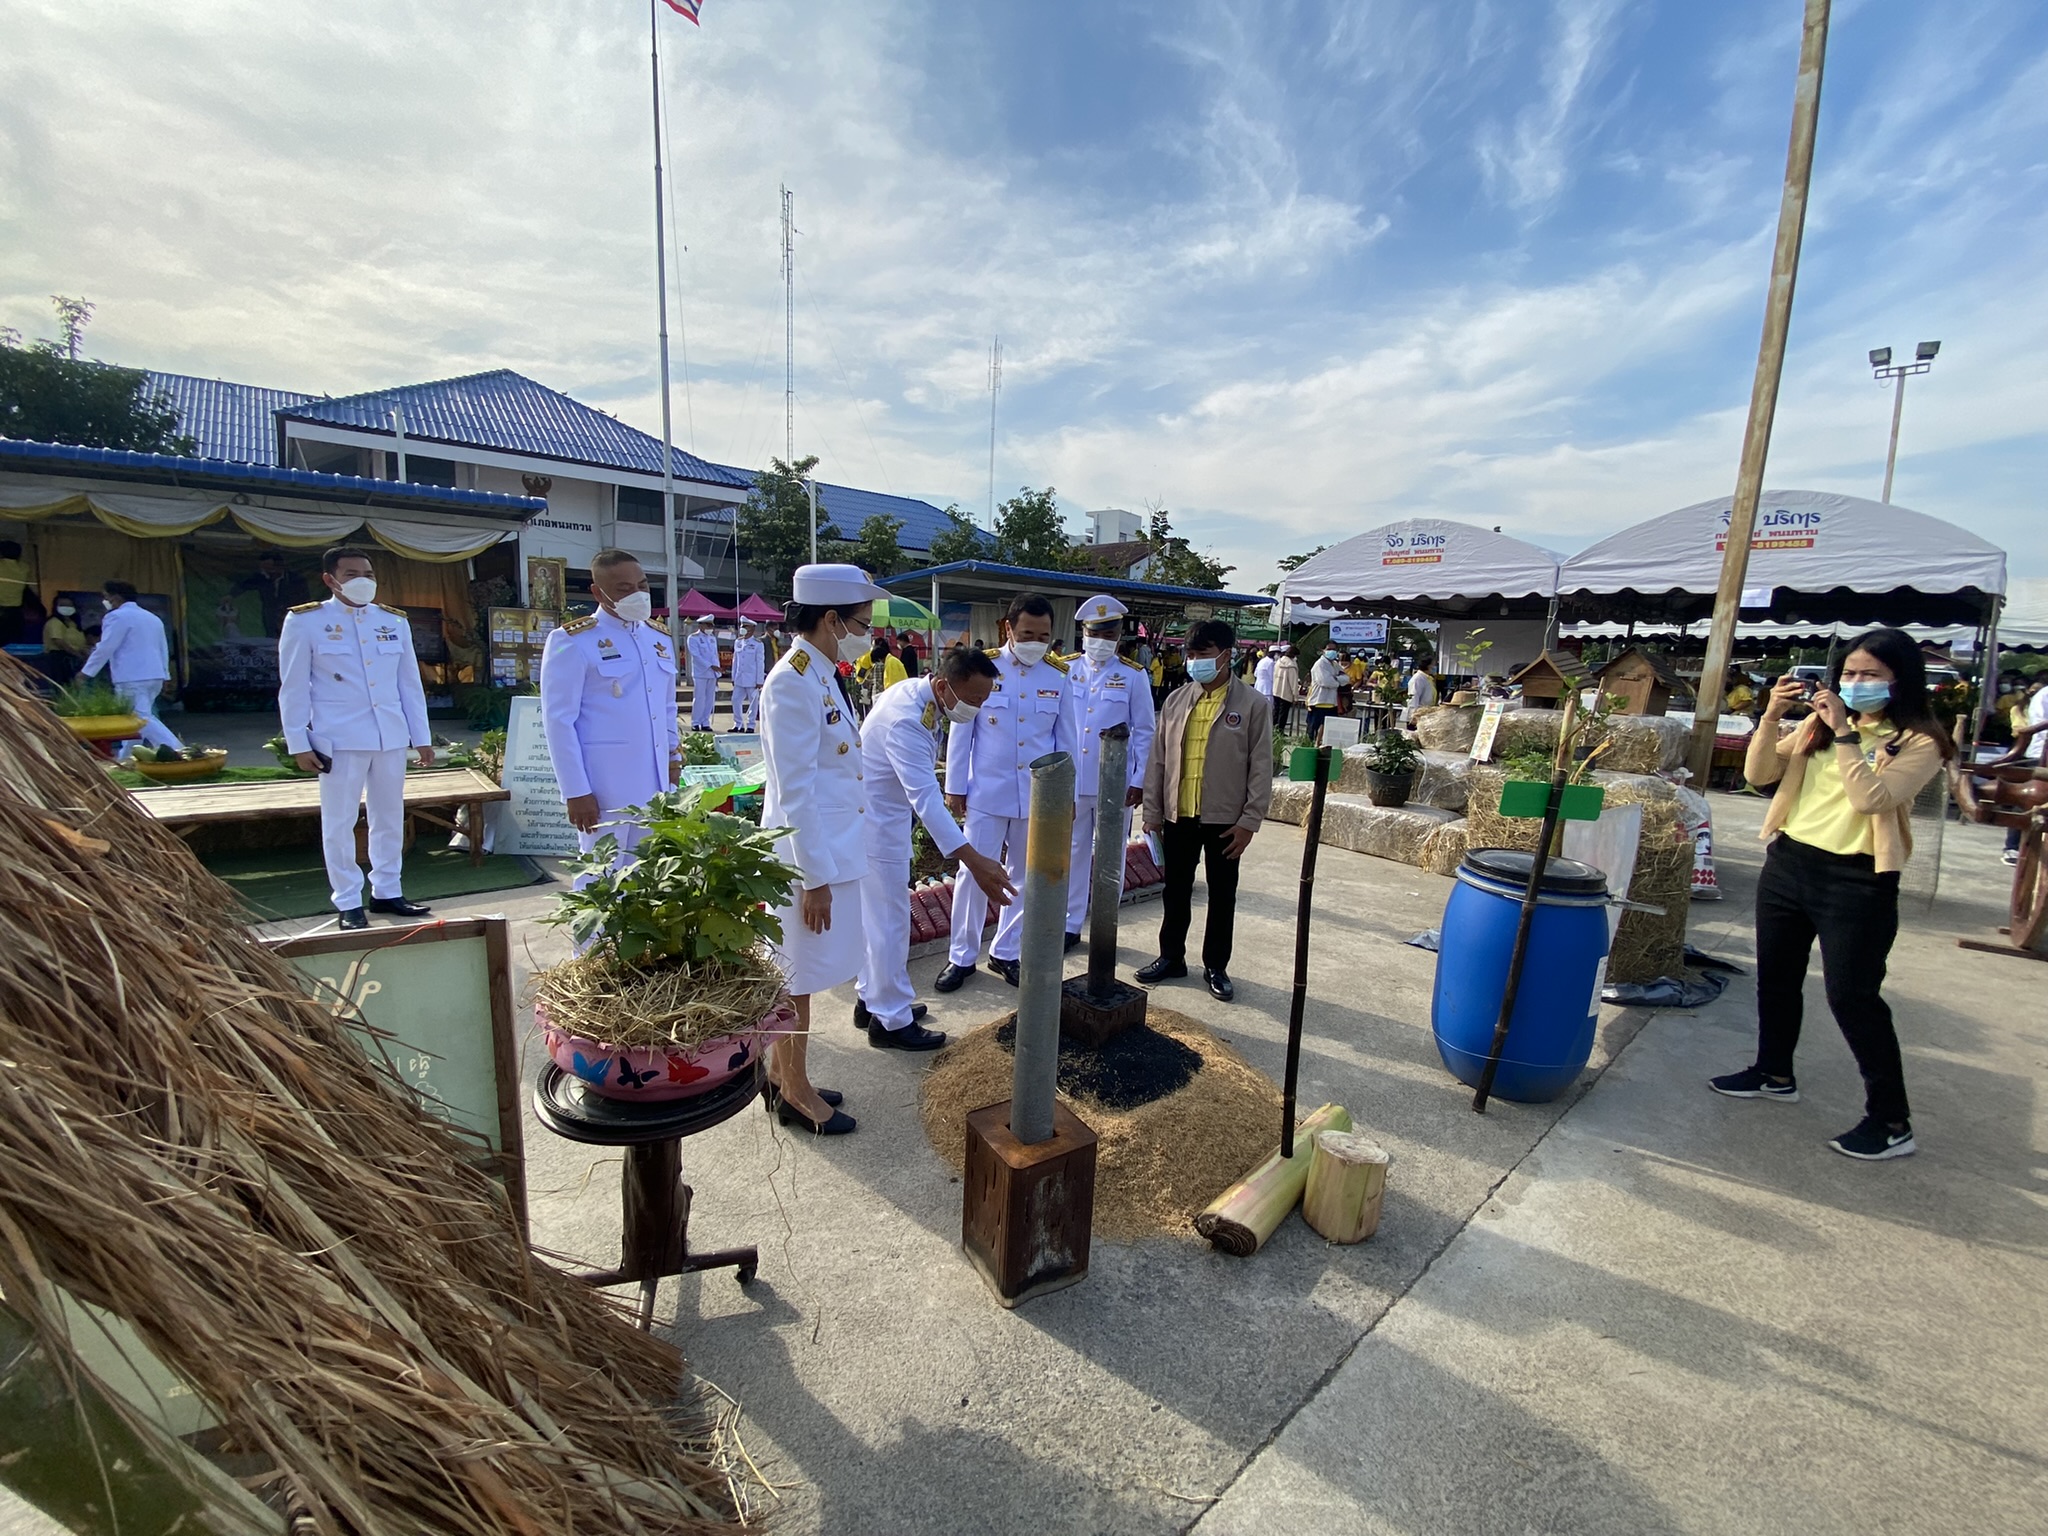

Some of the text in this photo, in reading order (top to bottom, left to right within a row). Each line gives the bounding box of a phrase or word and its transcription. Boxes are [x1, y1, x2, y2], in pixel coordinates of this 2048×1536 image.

[1763, 509, 1821, 528] บริการ
[1410, 533, 1446, 547] บริการ
[898, 619, 920, 627] BAAC
